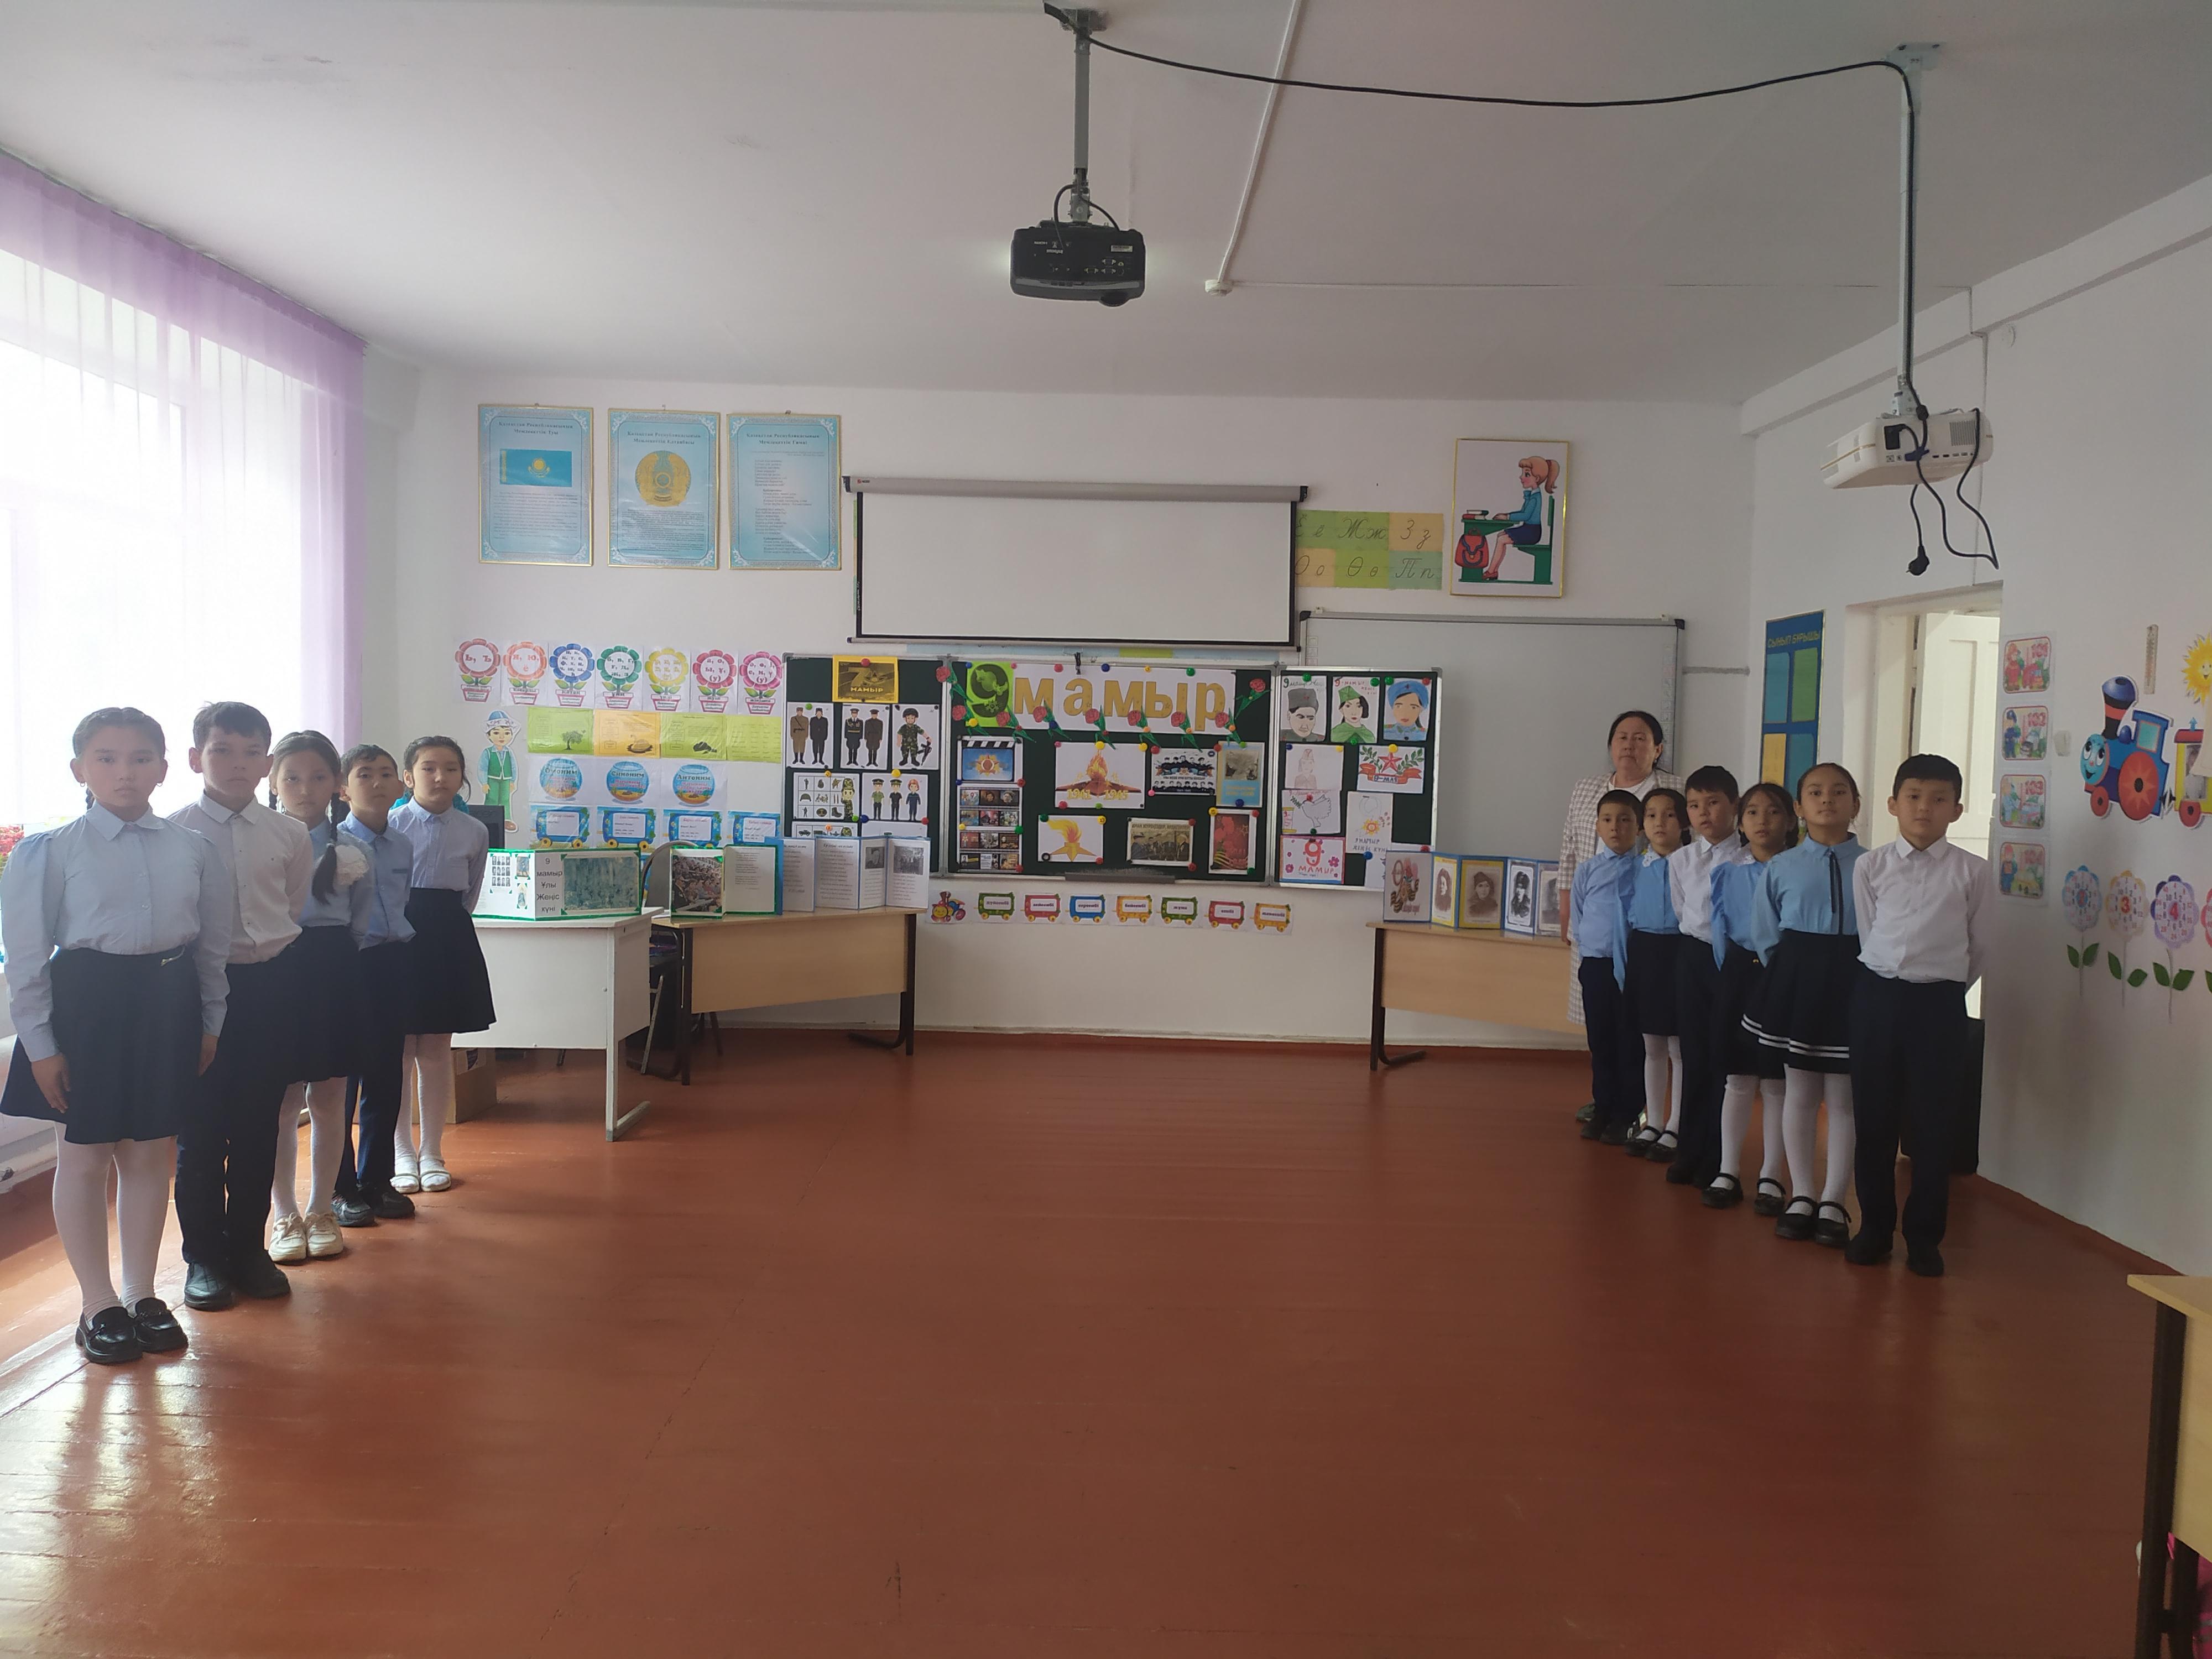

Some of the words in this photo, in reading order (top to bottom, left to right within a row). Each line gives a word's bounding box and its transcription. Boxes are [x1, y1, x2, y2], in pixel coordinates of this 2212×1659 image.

[1284, 677, 1290, 688] 9
[970, 664, 1009, 718] 9
[1014, 677, 1226, 732] мамыр
[1067, 789, 1092, 800] 1941
[1103, 789, 1129, 800] 1945
[1305, 840, 1322, 867] 9
[2121, 896, 2130, 914] 3
[2169, 901, 2179, 920] 4
